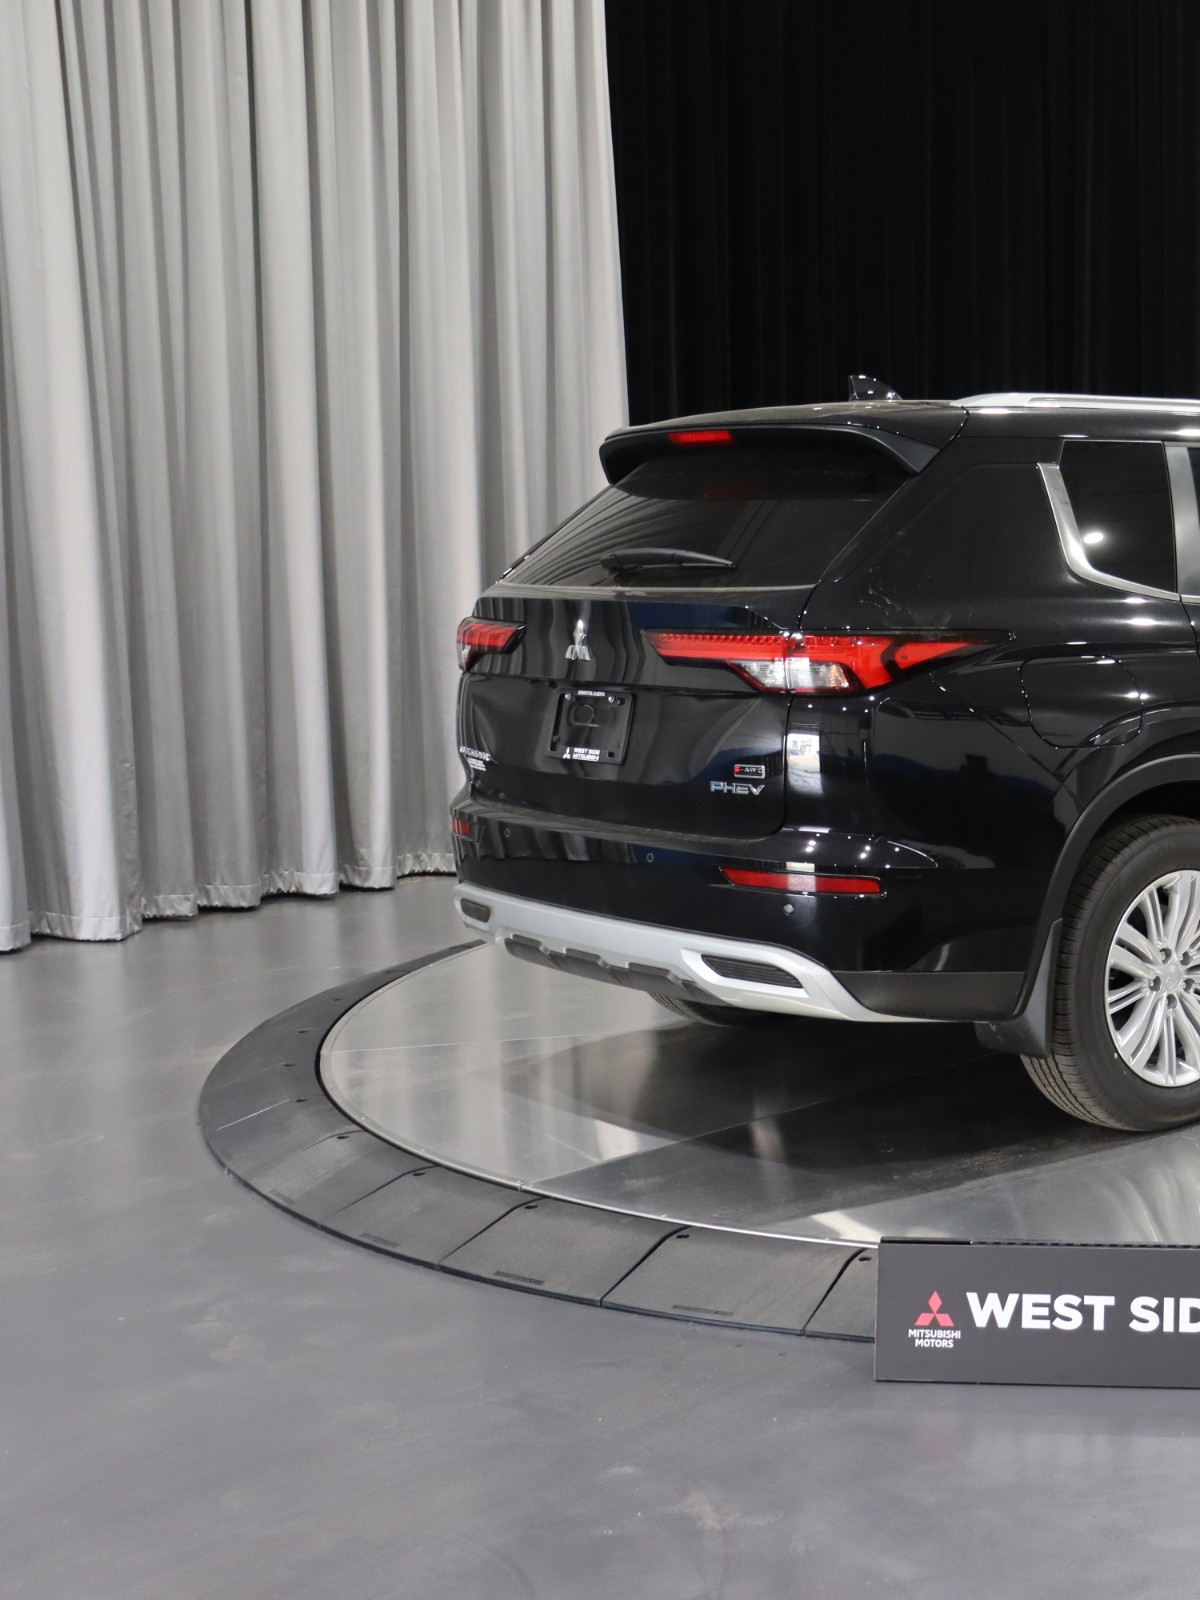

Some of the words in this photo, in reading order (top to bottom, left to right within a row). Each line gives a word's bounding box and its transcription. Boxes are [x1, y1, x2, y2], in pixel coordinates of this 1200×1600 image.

[710, 781, 765, 795] PHEV
[966, 1291, 1115, 1331] WEST
[908, 1328, 961, 1339] MITSUBISHI
[915, 1338, 954, 1348] MOTORS
